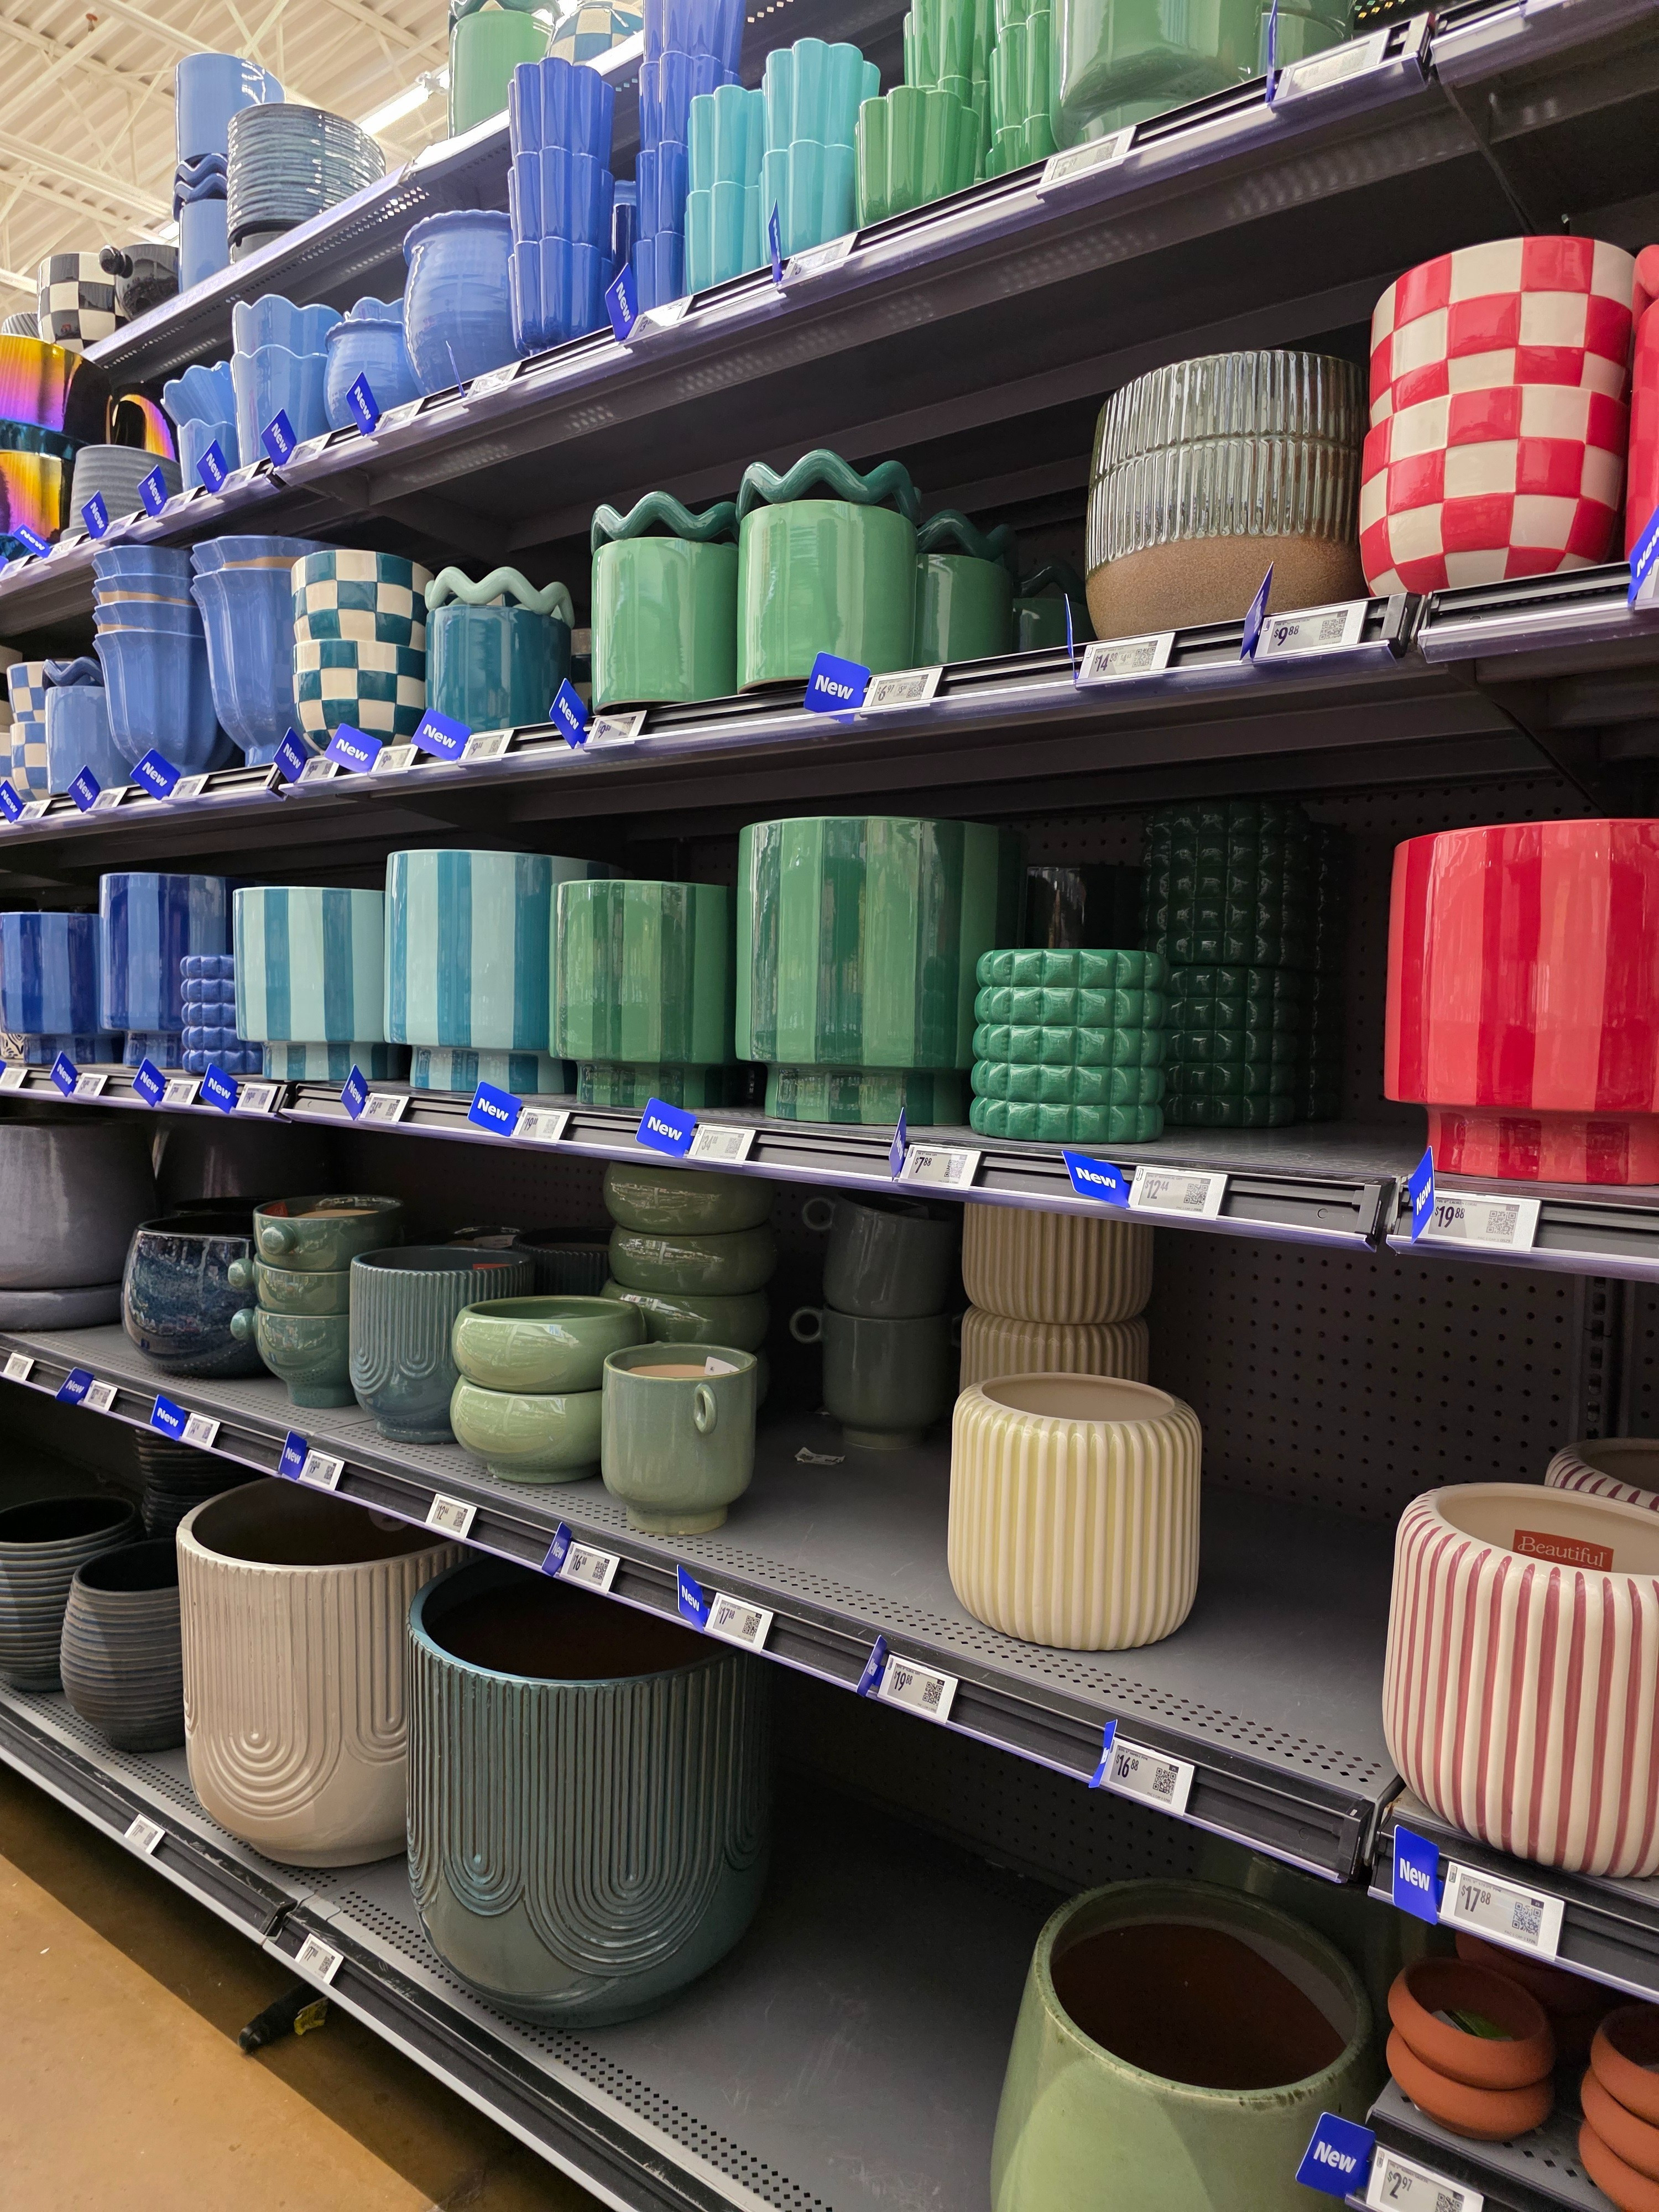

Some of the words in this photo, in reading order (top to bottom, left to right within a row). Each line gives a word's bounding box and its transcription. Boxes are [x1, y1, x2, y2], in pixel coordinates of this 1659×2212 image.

[616, 281, 631, 322] New
[354, 385, 372, 420] New
[271, 422, 288, 453] New
[206, 452, 222, 482] New
[147, 477, 162, 505] New
[90, 502, 105, 529] New
[20, 529, 45, 550] New
[815, 674, 854, 700] New
[559, 696, 579, 730] New
[422, 724, 456, 749] New
[283, 743, 301, 769] New
[336, 738, 368, 761] New
[142, 761, 168, 787] New
[1, 789, 18, 813] New
[76, 778, 93, 801] New
[56, 1063, 72, 1085] New
[140, 1071, 159, 1093] New
[208, 1078, 231, 1099] New
[348, 1079, 362, 1104] New
[477, 1098, 509, 1121] New
[647, 1116, 682, 1141] New
[1075, 1167, 1116, 1189] New
[1416, 1177, 1431, 1216] New
[65, 1380, 85, 1393] New
[156, 1407, 179, 1427] New
[285, 1447, 301, 1464] New
[551, 1541, 565, 1559] New
[1517, 1536, 1604, 1568] Beautiful
[681, 1584, 700, 1612] New
[1400, 1858, 1430, 1892] New
[1313, 2141, 1357, 2173] New
